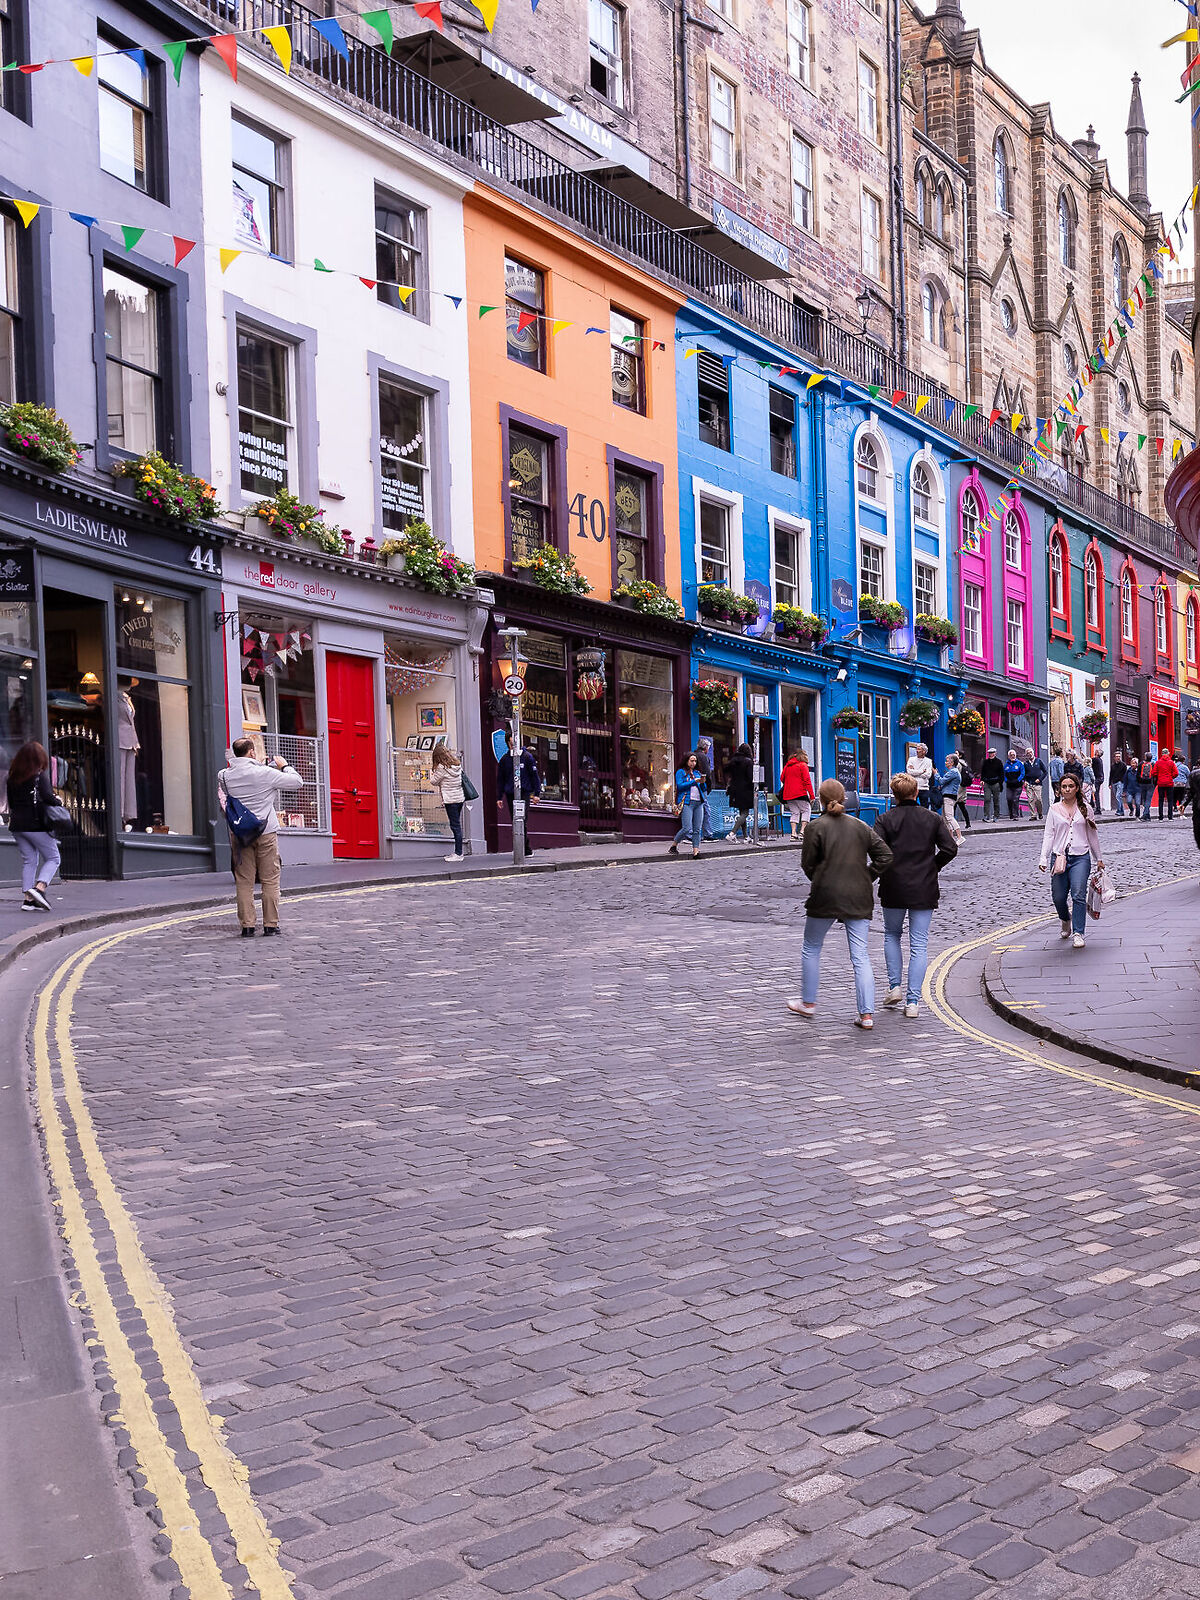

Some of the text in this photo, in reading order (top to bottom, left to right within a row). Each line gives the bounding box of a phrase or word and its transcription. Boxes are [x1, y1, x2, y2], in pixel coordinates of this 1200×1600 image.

[557, 101, 613, 150] KANAM
[239, 431, 262, 449] oving
[262, 437, 285, 456] Local
[244, 447, 260, 462] and
[260, 450, 288, 471] Design
[261, 465, 283, 483] 2003
[620, 495, 635, 509] BEST
[35, 502, 128, 548] LADIESWEAR
[569, 493, 606, 543] 40
[244, 566, 337, 600] the red door gallery
[388, 602, 457, 623] www.edinburghart.com
[121, 616, 147, 636] TWEED
[506, 680, 523, 691] 20
[521, 690, 559, 714] USEUM
